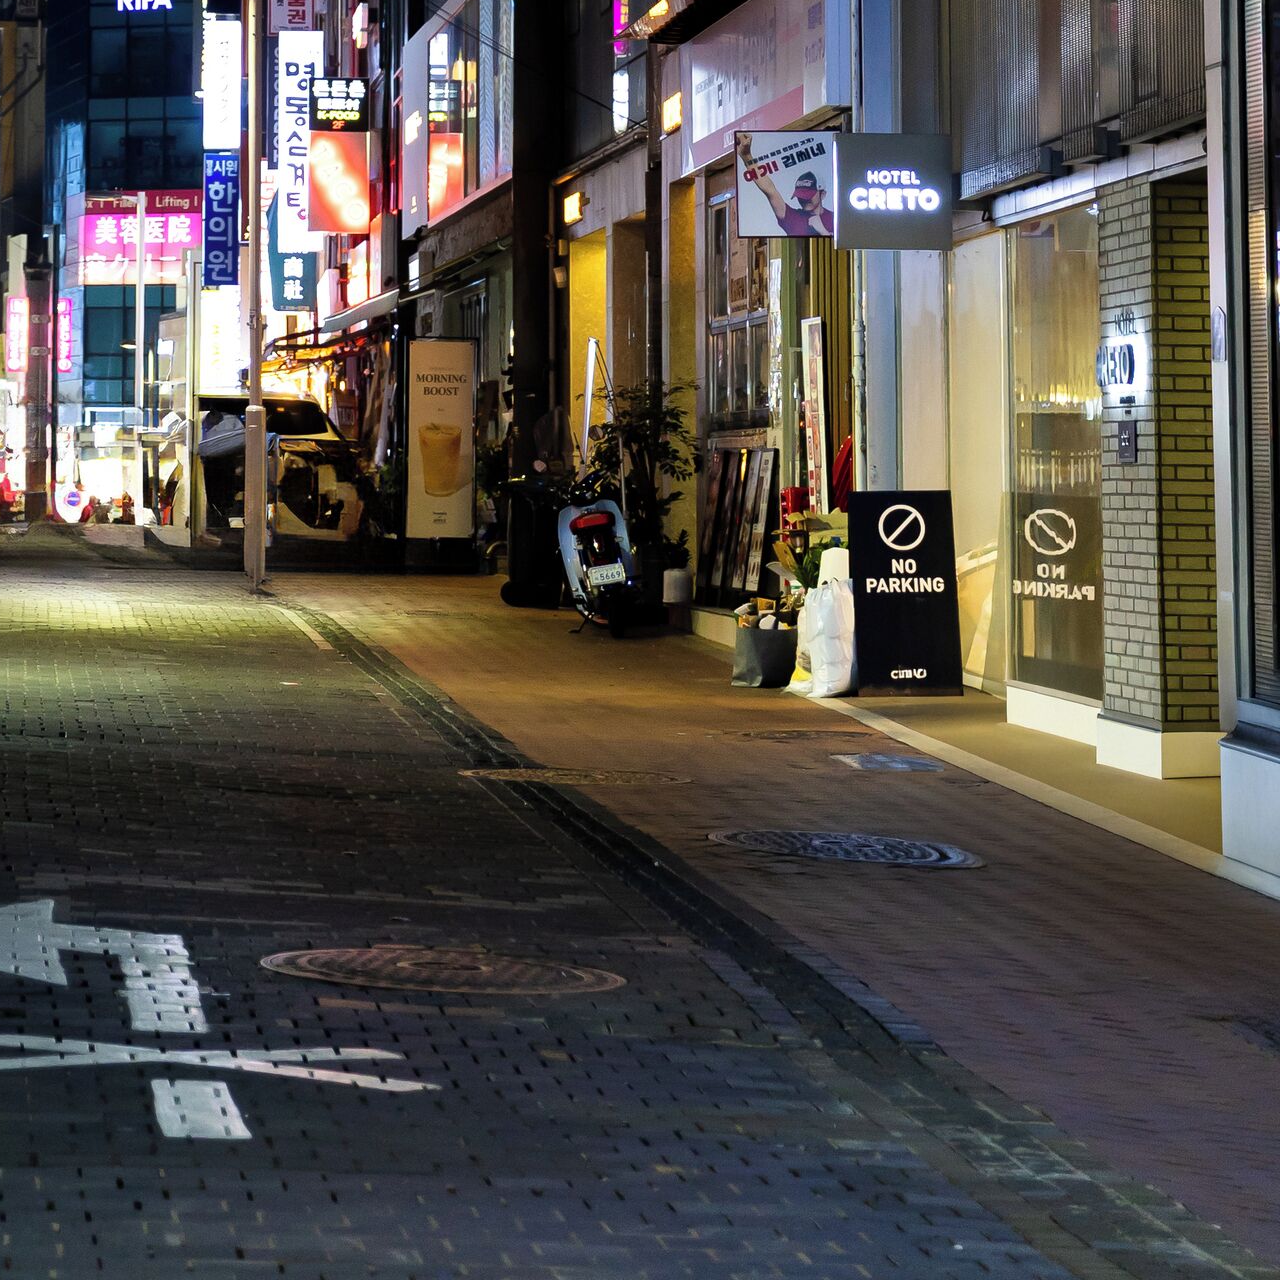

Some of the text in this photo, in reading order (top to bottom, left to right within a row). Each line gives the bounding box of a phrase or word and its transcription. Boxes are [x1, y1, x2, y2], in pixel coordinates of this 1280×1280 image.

[317, 110, 360, 120] K-FOOD
[332, 120, 345, 129] 2F
[866, 169, 921, 187] HOTEL
[155, 195, 191, 210] Lifting
[848, 187, 941, 212] CRETO
[207, 181, 236, 282] 한의원
[416, 374, 467, 384] MORNING
[423, 386, 459, 396] BOOST
[891, 559, 916, 574] NO
[866, 577, 945, 593] PARKING
